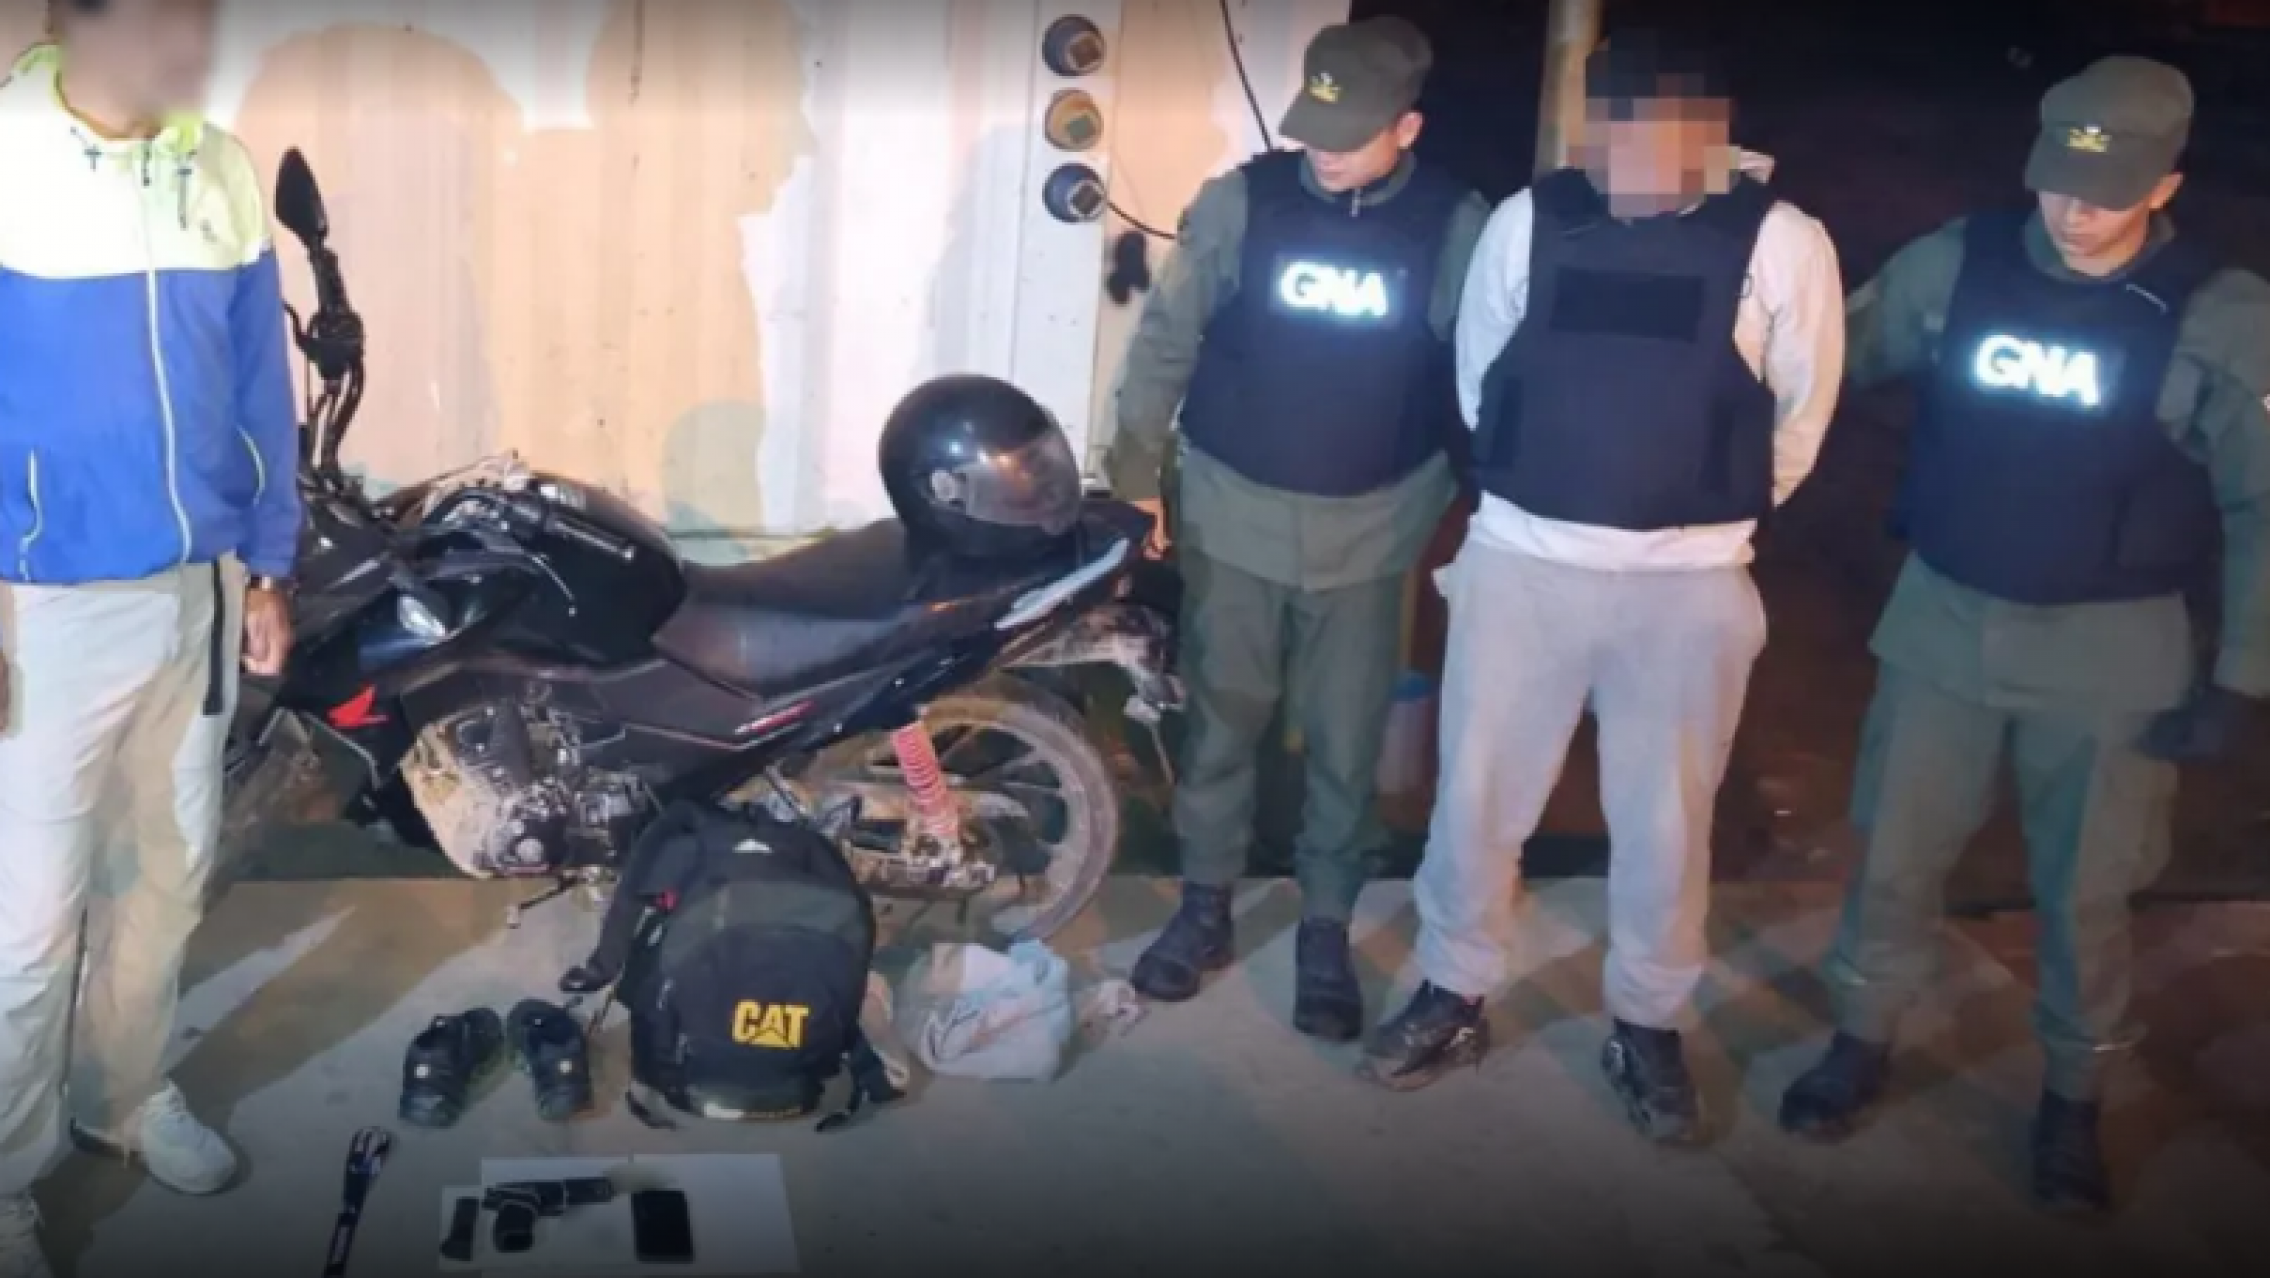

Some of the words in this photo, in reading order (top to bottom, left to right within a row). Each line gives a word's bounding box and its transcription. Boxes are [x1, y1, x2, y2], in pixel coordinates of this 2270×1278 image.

[1279, 260, 1388, 317] GNA
[1974, 334, 2100, 406] GNA
[732, 999, 810, 1048] CAT
